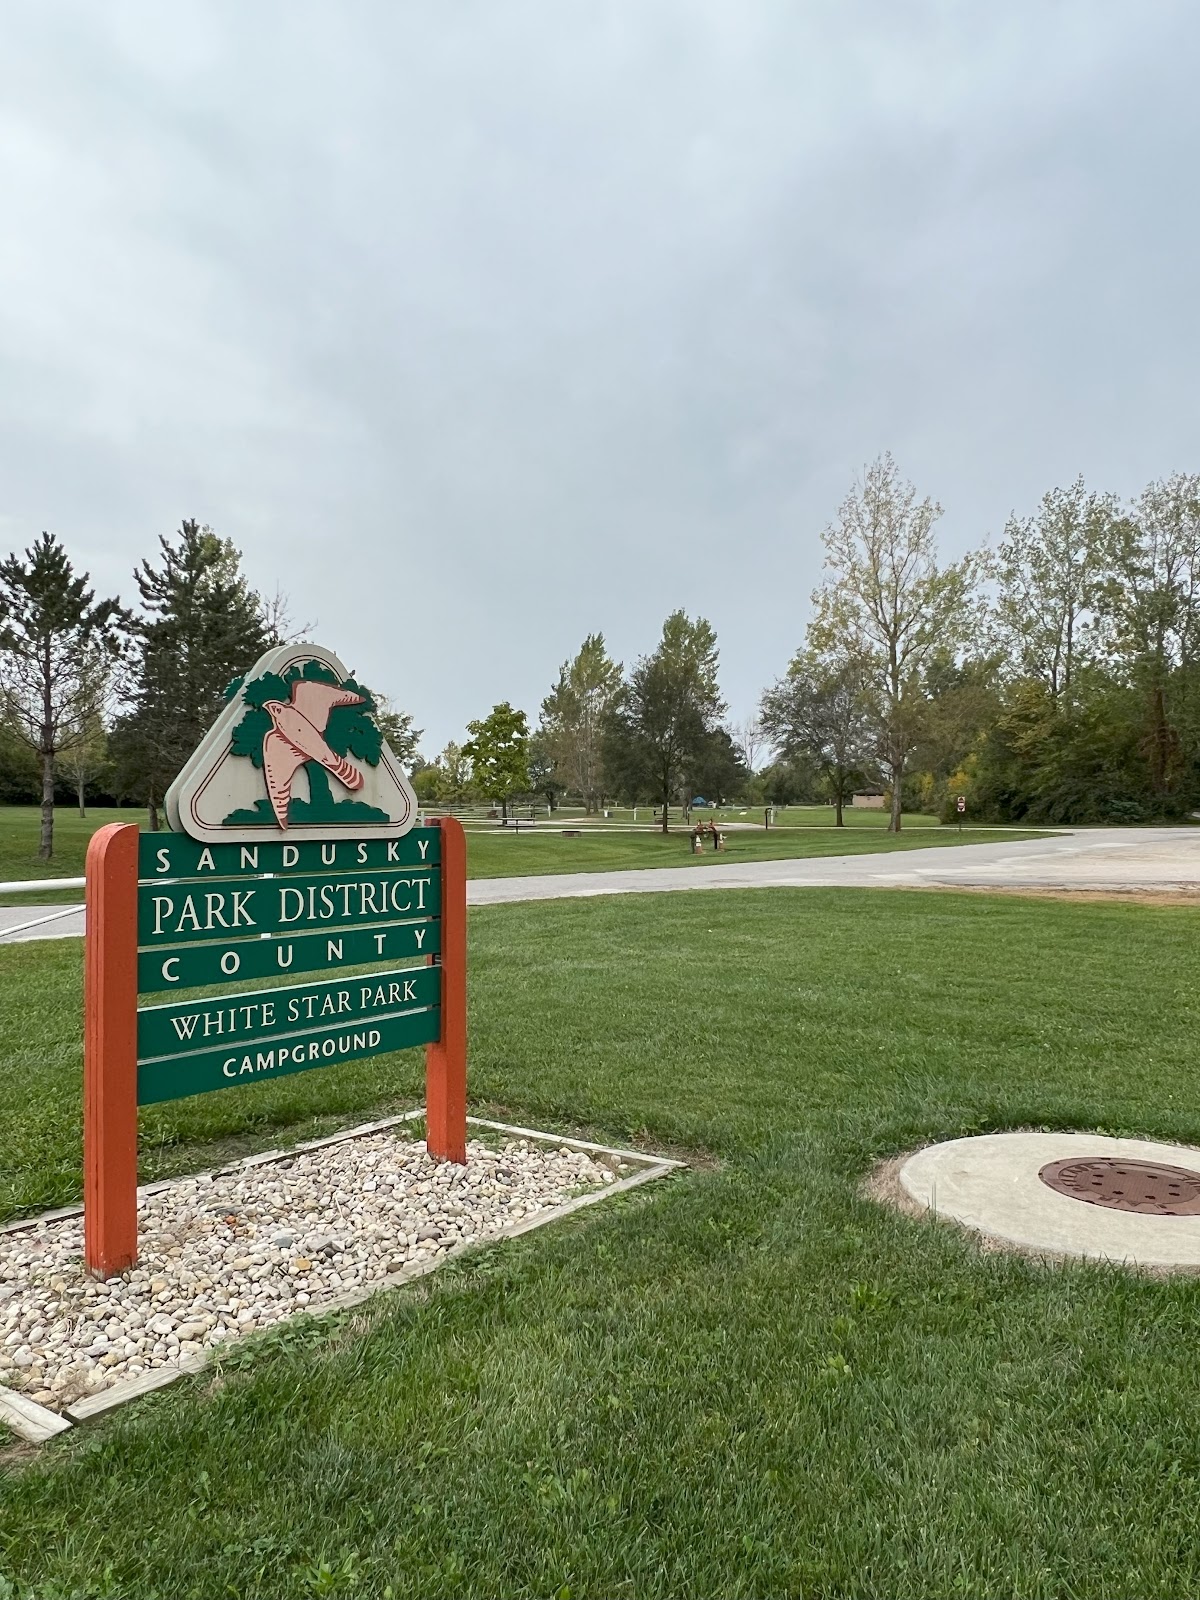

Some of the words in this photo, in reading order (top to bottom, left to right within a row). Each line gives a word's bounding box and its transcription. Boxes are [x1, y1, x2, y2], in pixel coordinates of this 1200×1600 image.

[156, 840, 430, 873] SANDUSKY
[151, 890, 257, 935] PARK
[278, 877, 431, 923] DISTRICT
[161, 928, 427, 982] COUNTY
[170, 1002, 277, 1041] WHITE
[287, 990, 353, 1022] STAR
[360, 979, 418, 1009] PARK
[222, 1030, 382, 1077] CAMPGROUND
